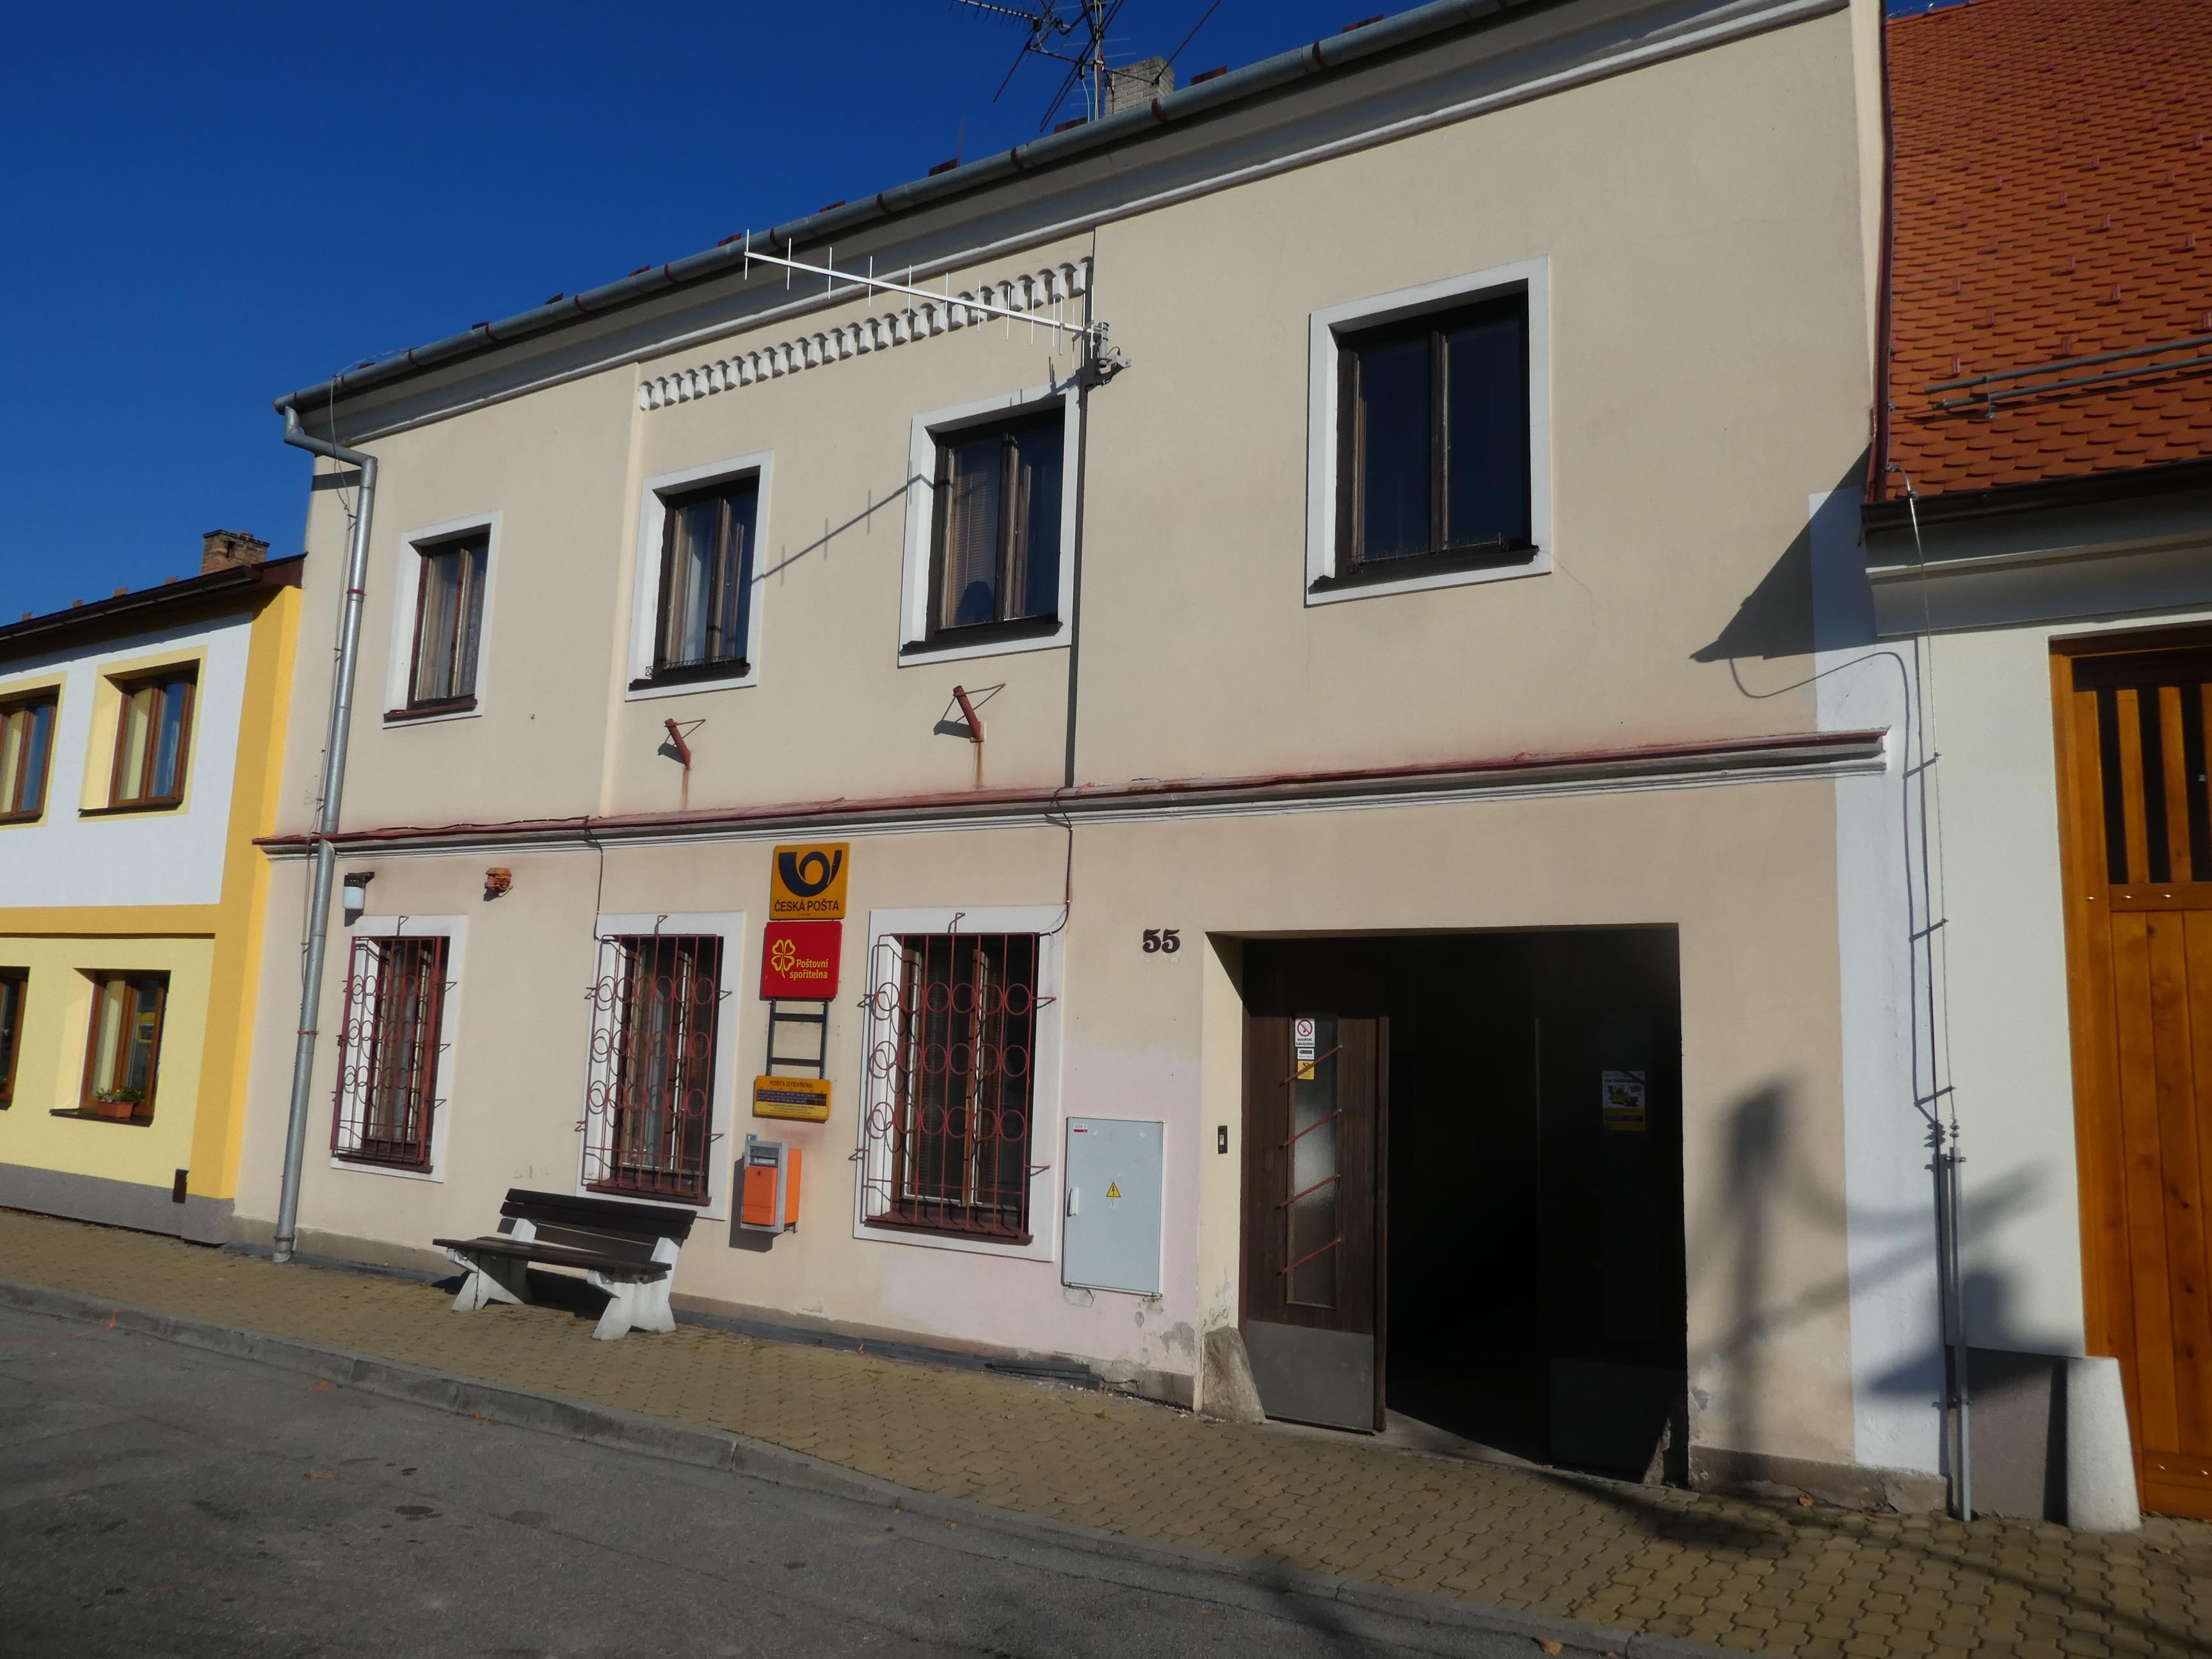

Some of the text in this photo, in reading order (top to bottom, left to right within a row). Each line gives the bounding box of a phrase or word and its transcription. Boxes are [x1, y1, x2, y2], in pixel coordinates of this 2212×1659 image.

[774, 898, 839, 911] ČESKÁ POŠTA
[1142, 929, 1180, 953] 55
[796, 958, 829, 968] Poštovní
[789, 969, 828, 981] spořitelna
